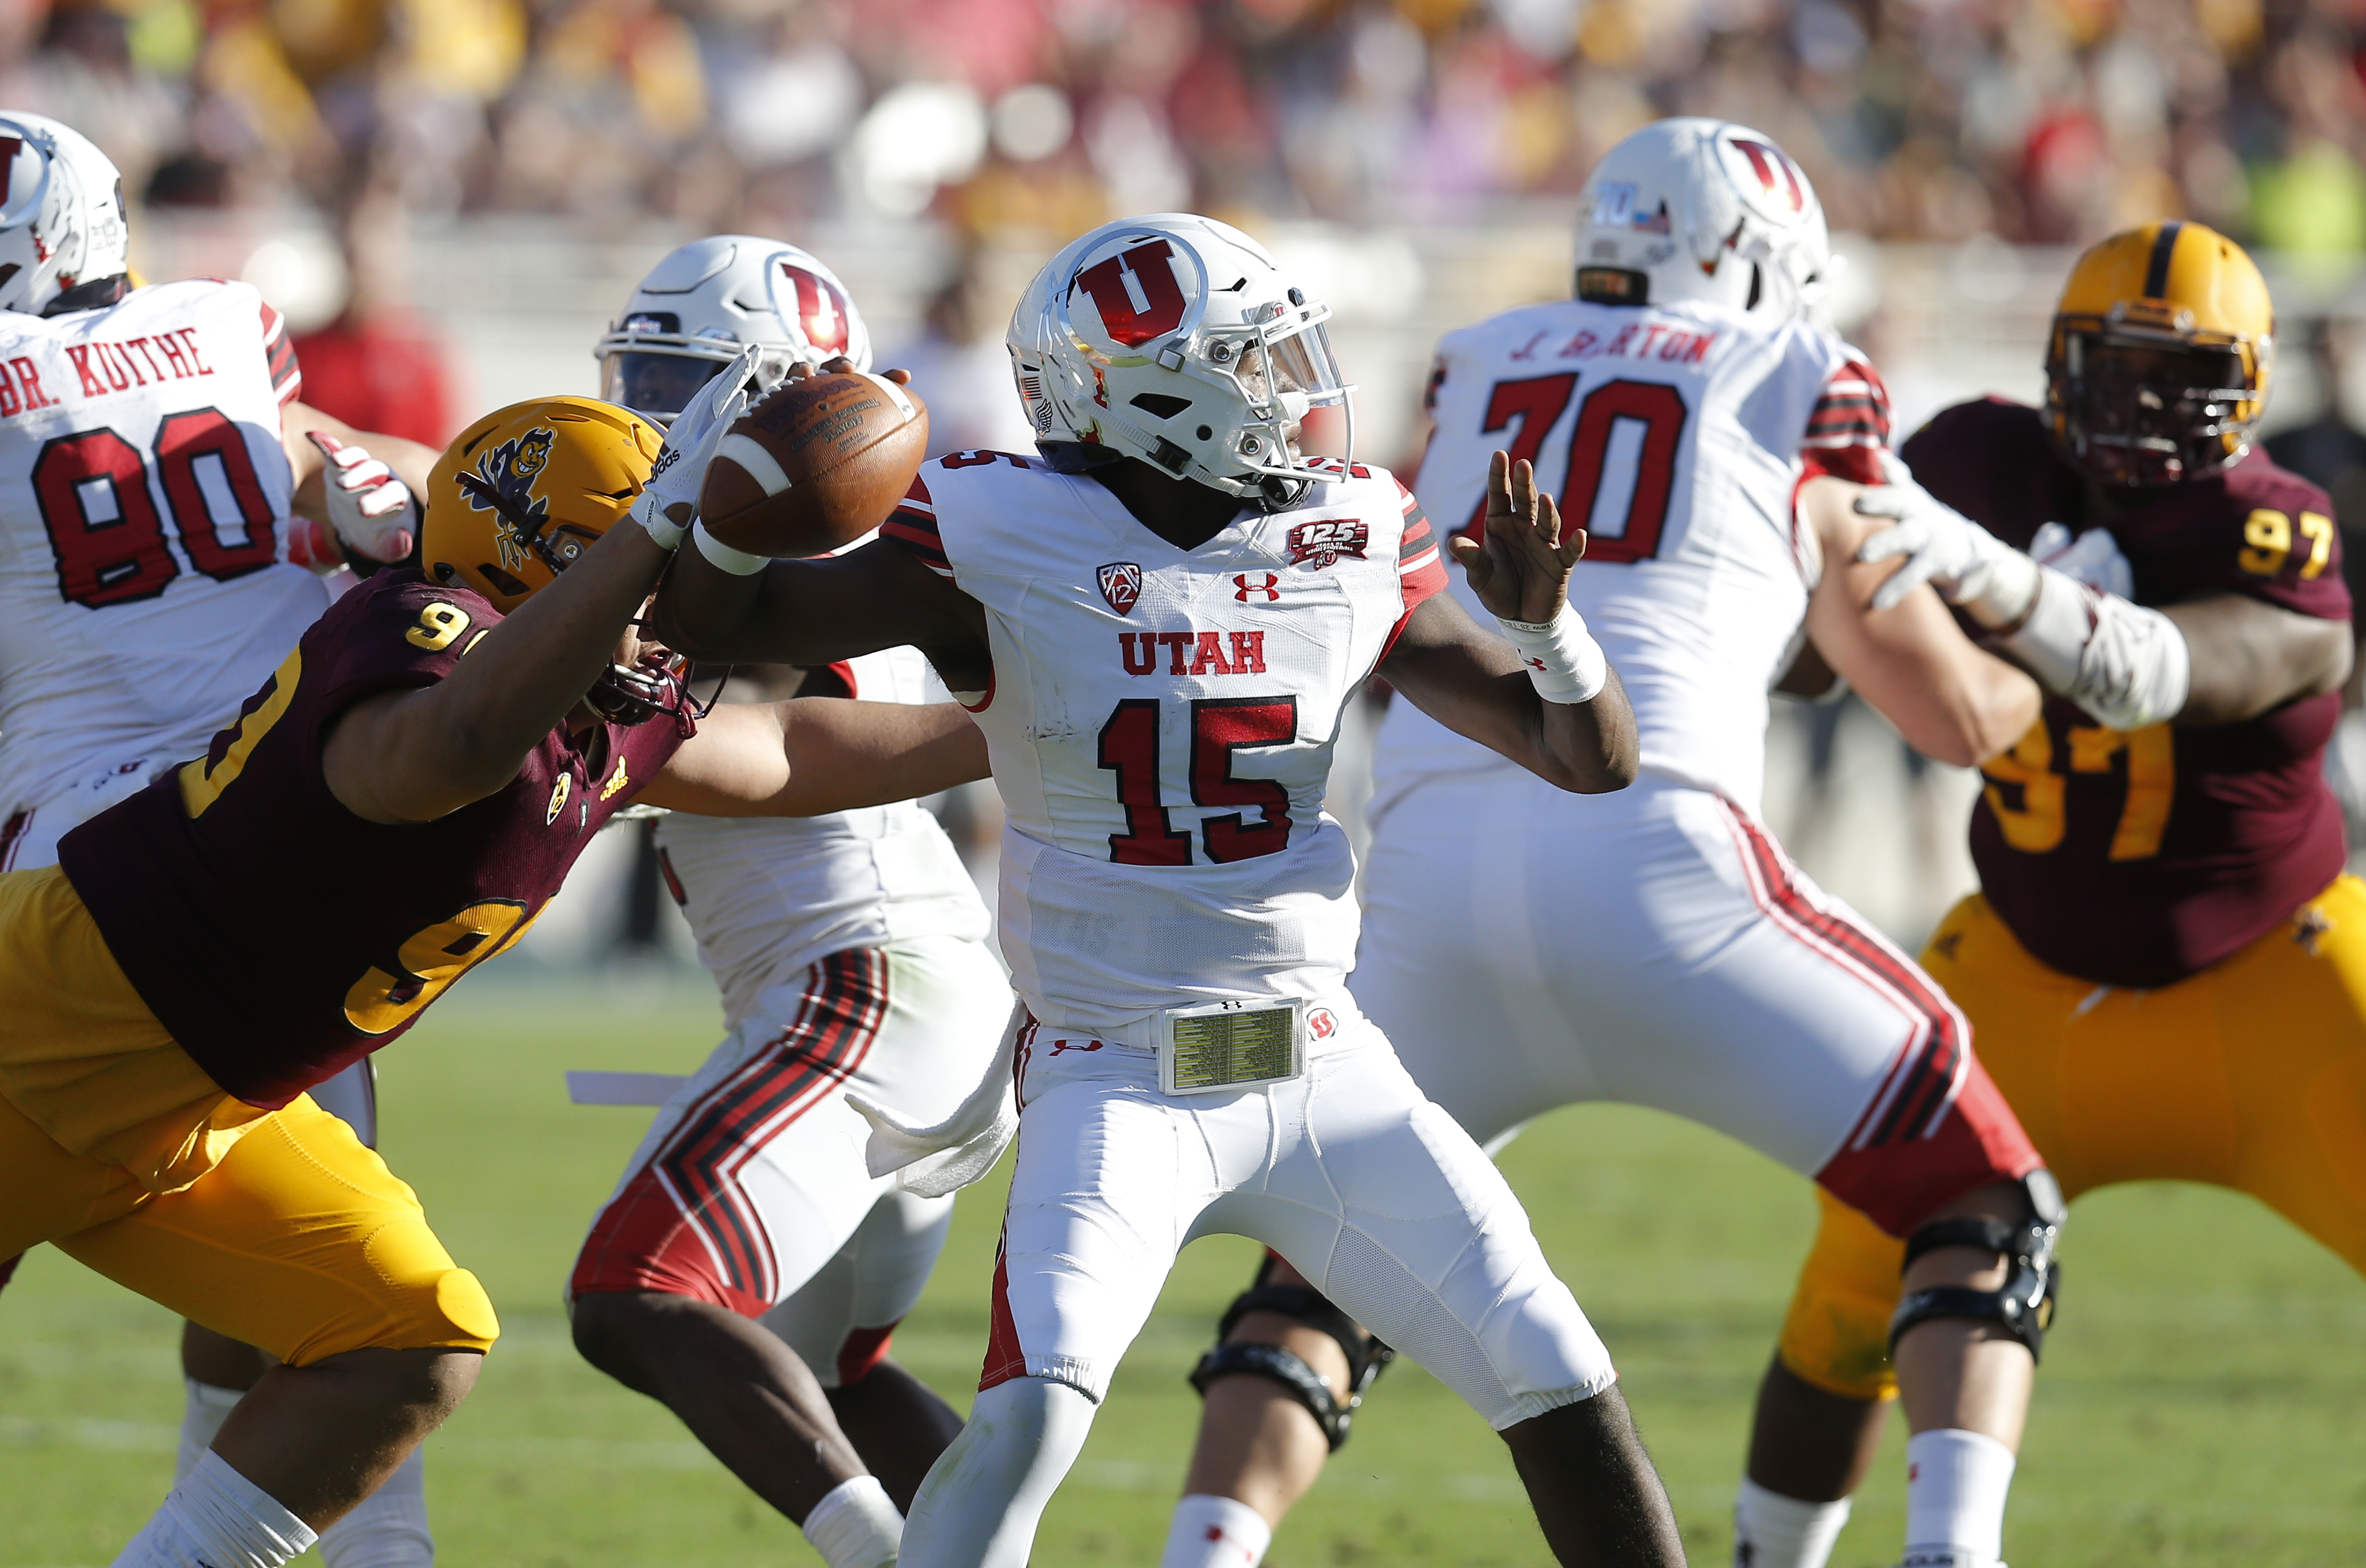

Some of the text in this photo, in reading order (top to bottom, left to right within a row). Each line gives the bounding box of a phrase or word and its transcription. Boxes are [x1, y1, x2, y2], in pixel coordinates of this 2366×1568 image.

[780, 263, 848, 356] U
[1074, 239, 1186, 349] U
[65, 327, 214, 398] KUITHE
[822, 414, 863, 443] PLAYOFF
[833, 398, 881, 421] FOOTBALL
[1448, 372, 1688, 564] 70
[31, 406, 276, 610] 80
[1301, 522, 1357, 545] 125
[2238, 508, 2334, 580] 97
[1100, 564, 1140, 596] PAC
[1111, 584, 1134, 604] 12
[406, 601, 490, 657] 9
[1118, 630, 1266, 676] UTAH
[1097, 695, 1297, 867] 15
